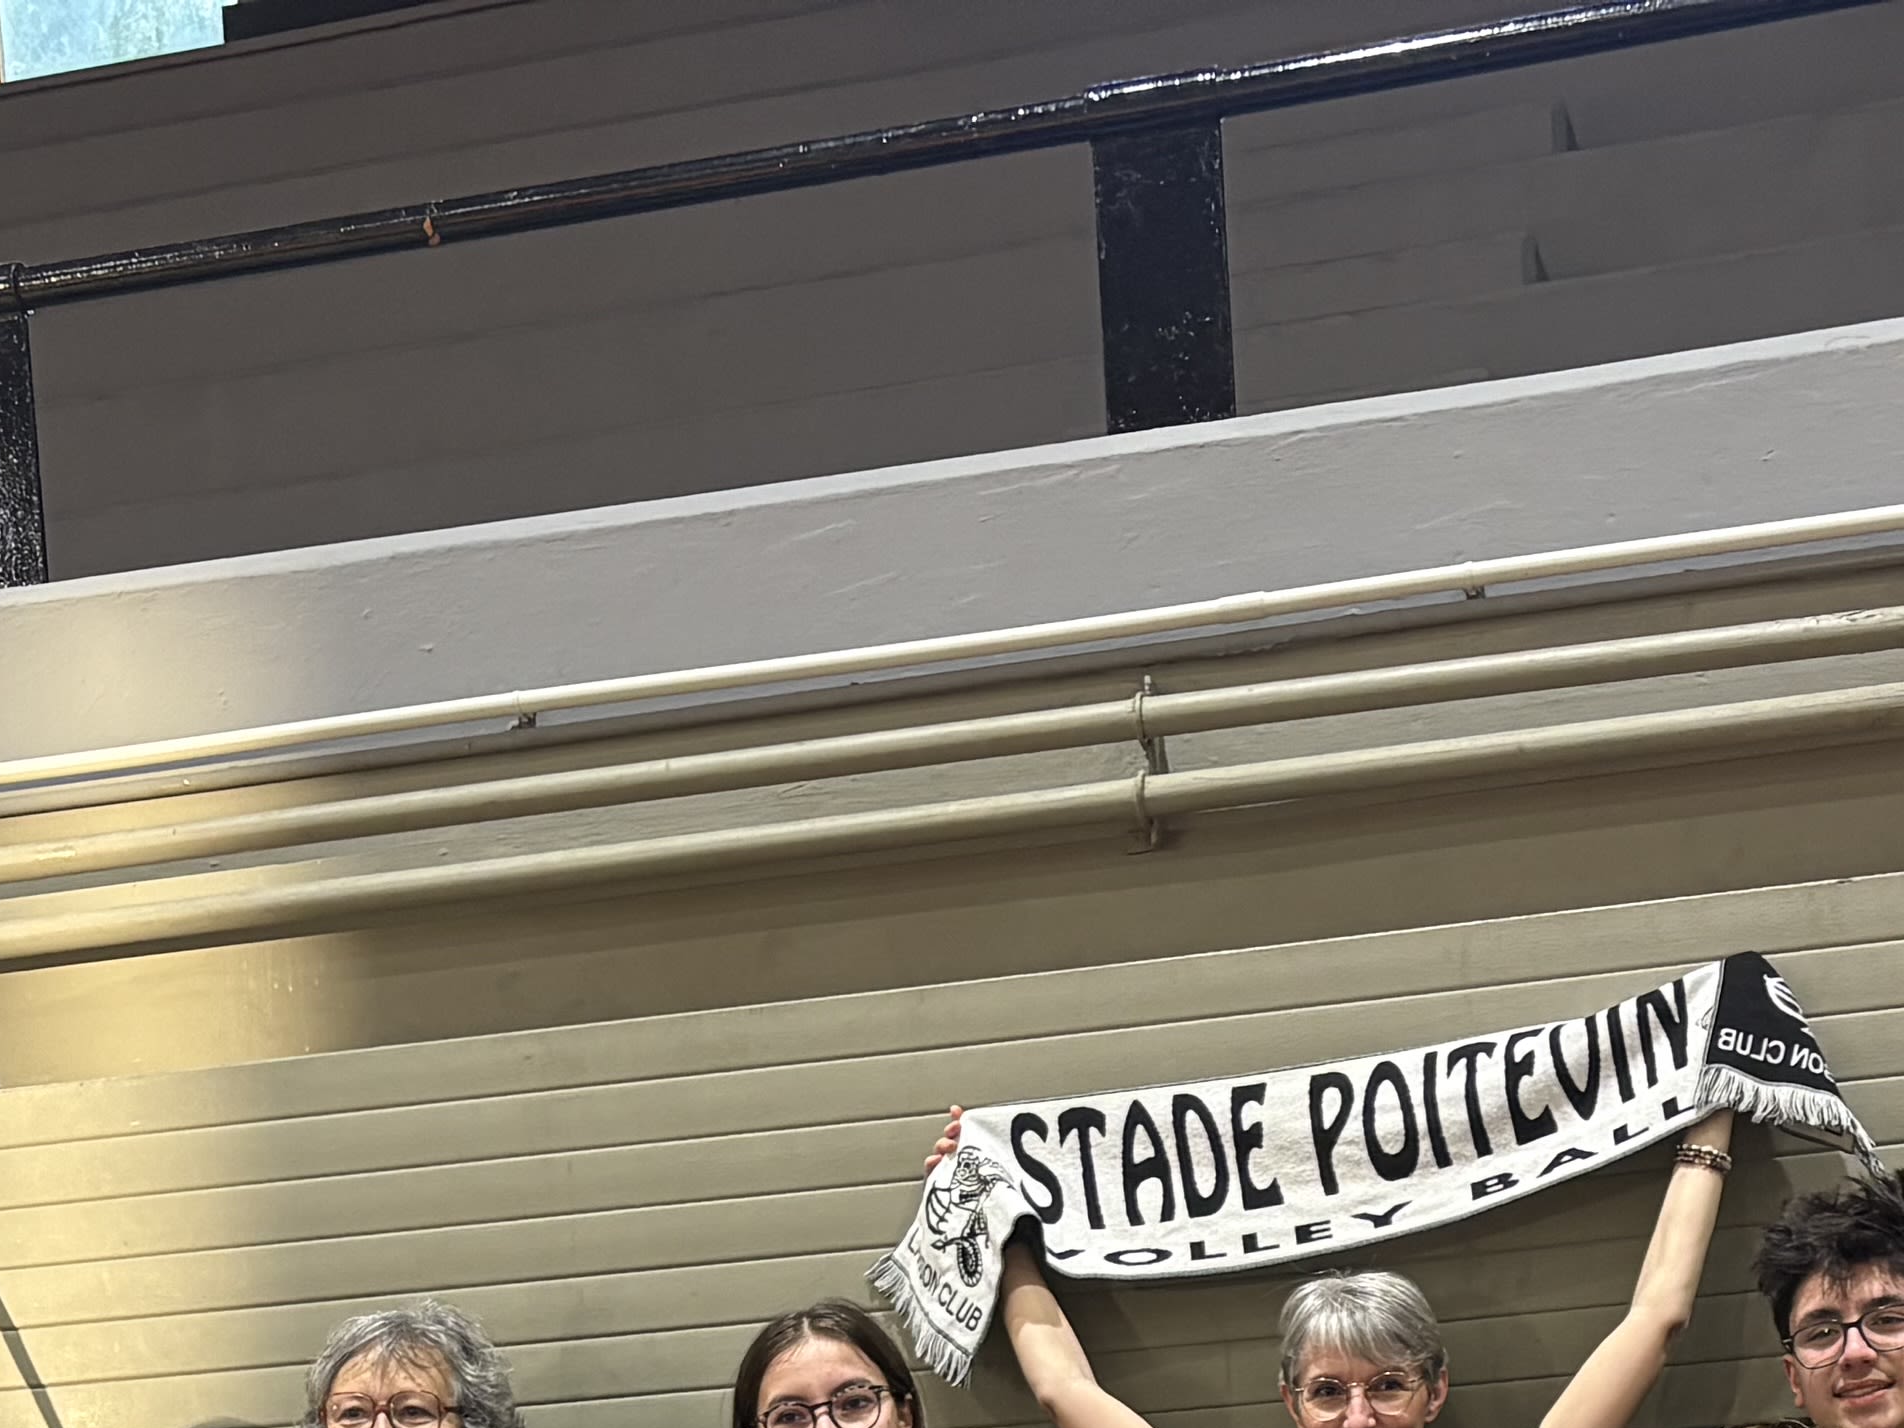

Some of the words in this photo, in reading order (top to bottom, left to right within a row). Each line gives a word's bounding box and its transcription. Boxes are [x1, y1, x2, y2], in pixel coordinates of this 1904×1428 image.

[1010, 1082, 1284, 1230] STADE
[1309, 978, 1688, 1196] POITEVIN
[1047, 1200, 1412, 1265] VOLLEY
[1471, 1096, 1697, 1201] BALL
[937, 1283, 984, 1331] CLUB
